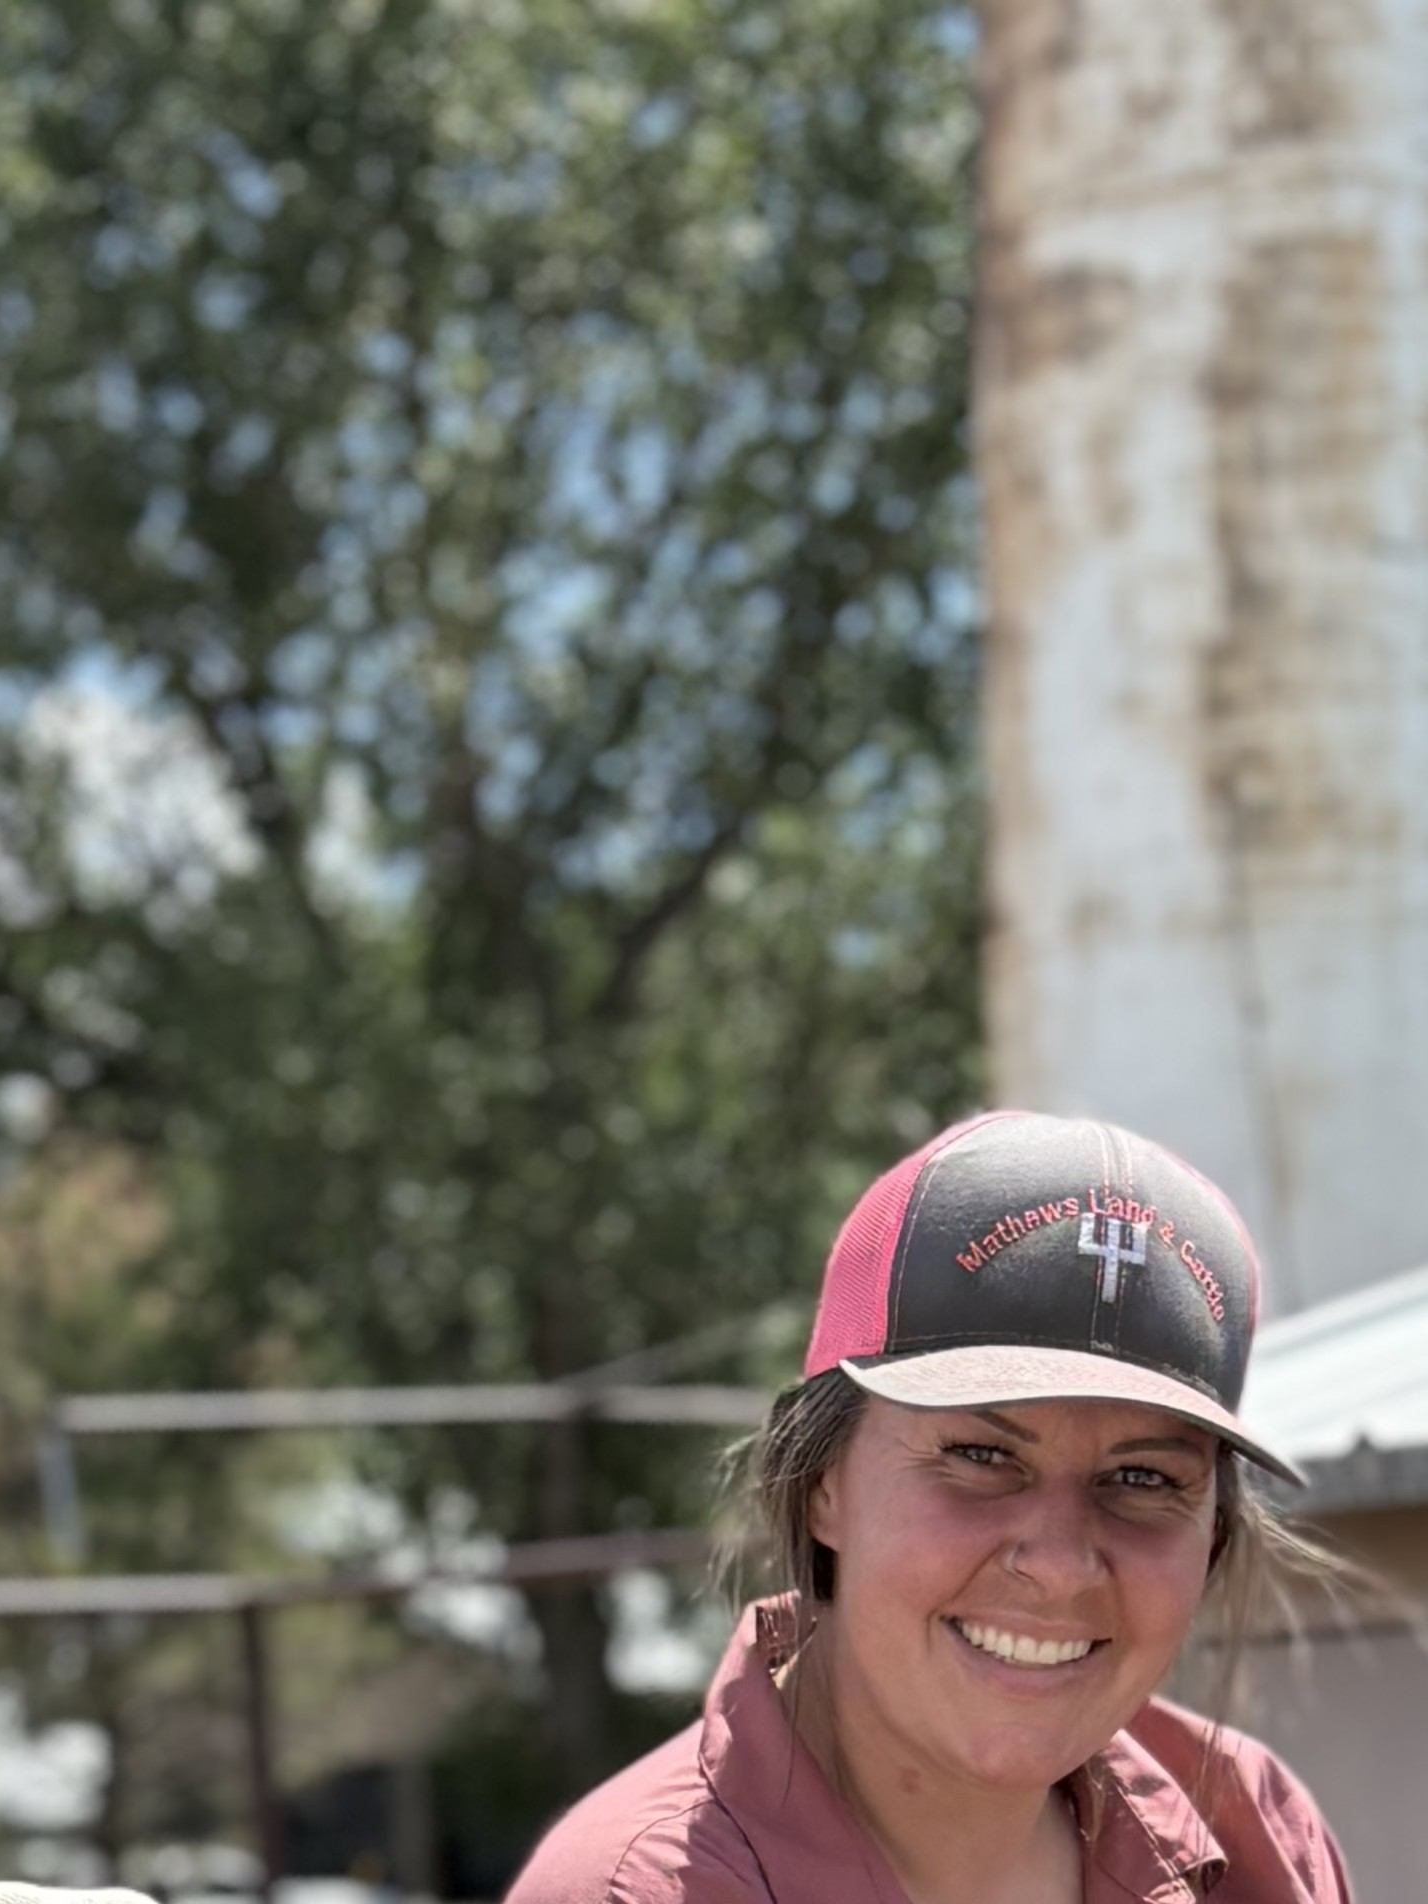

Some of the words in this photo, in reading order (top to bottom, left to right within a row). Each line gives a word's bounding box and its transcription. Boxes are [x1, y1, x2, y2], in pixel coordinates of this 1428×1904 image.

[955, 1197, 1080, 1273] Mathews
[1088, 1186, 1159, 1226] Land
[1158, 1219, 1177, 1250] &
